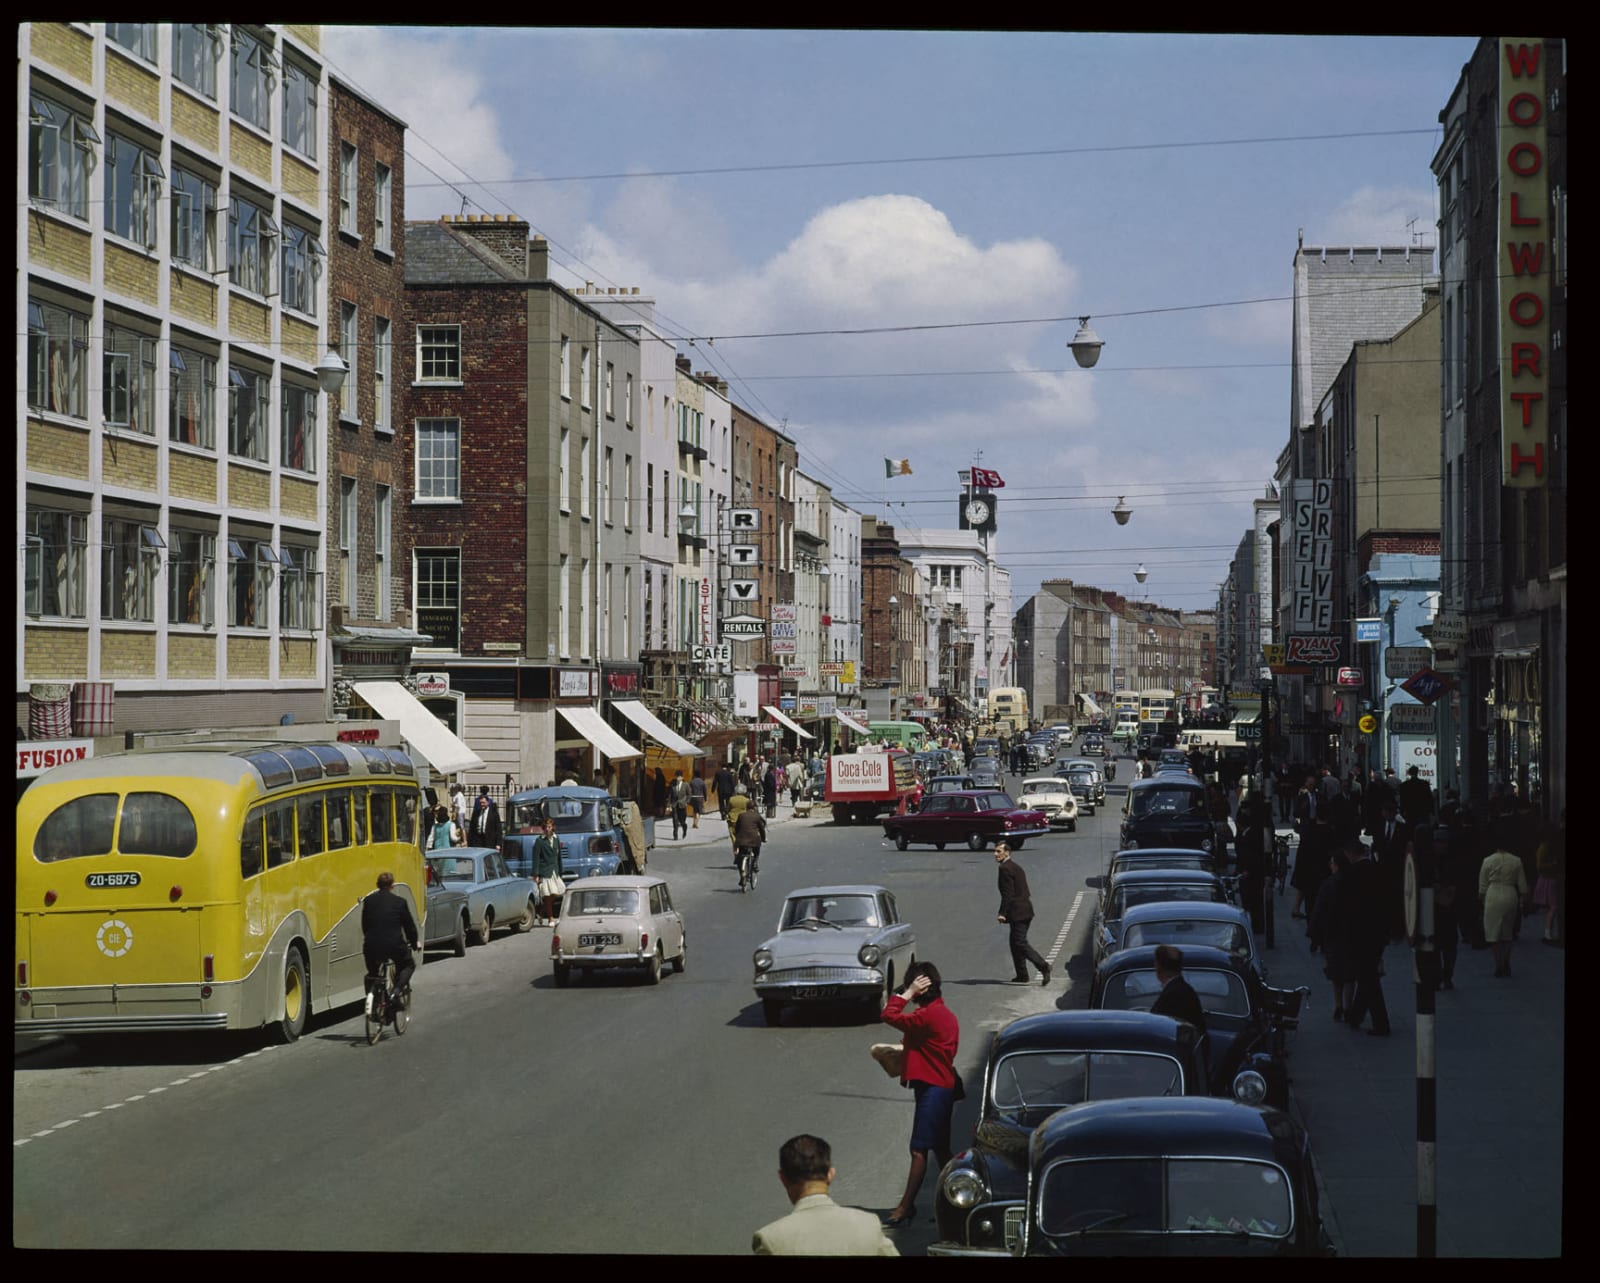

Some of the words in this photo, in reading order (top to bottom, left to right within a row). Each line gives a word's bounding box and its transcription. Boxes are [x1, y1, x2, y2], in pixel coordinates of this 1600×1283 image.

[1505, 43, 1544, 477] WOOLWORTH
[734, 513, 753, 597] RTV
[1299, 503, 1310, 619] SELF
[1316, 482, 1330, 629] DRIVE
[701, 585, 709, 645] STELLA
[724, 623, 763, 632] RENTALS
[1287, 636, 1342, 662] RYANS
[1238, 726, 1262, 738] bus
[19, 747, 86, 770] FUSION
[838, 760, 881, 777] Coca-Cola
[600, 935, 619, 945] 236
